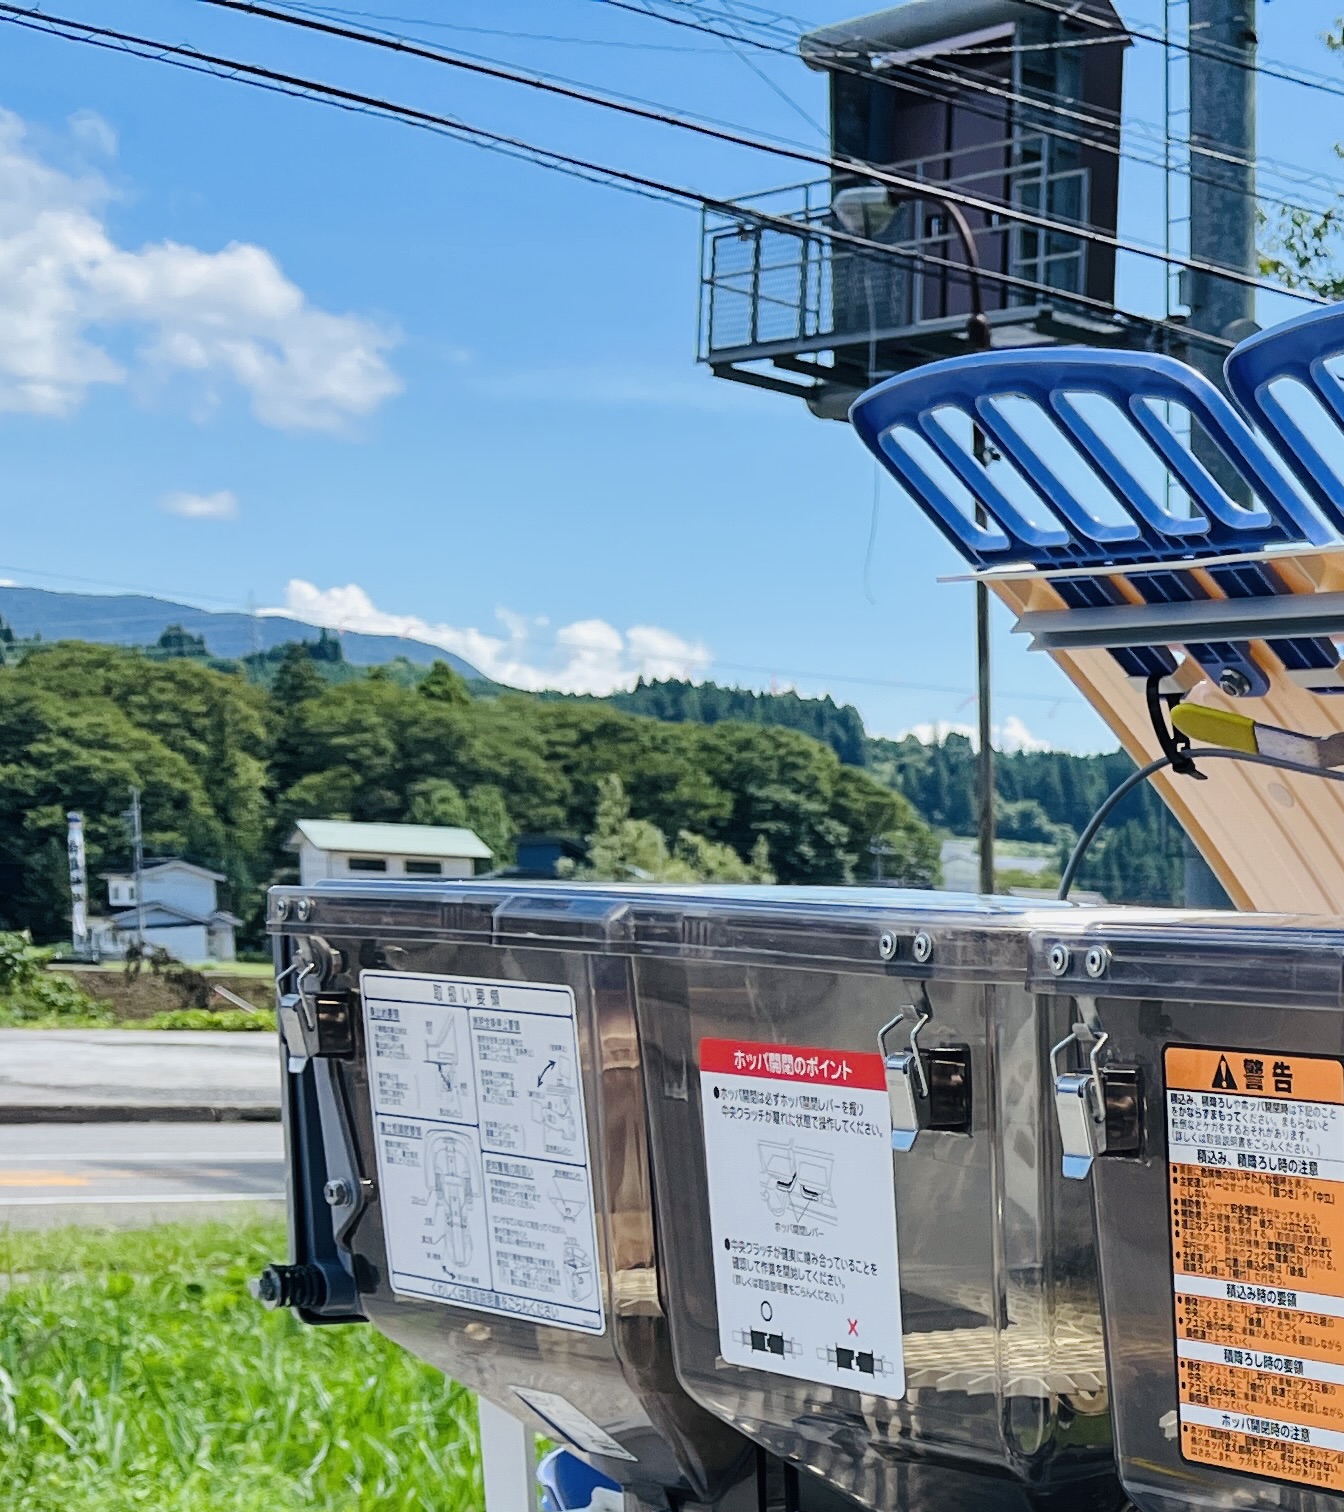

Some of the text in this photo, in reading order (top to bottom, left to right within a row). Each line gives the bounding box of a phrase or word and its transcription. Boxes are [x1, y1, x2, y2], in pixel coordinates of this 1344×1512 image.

[733, 1049, 853, 1081] ホッパ開閉のポイント
[1243, 1058, 1293, 1093] 警告
[1197, 1148, 1318, 1176] 積込み、積降ろし時の注意
[1226, 1282, 1297, 1307] 積込み時の要領
[1224, 1348, 1303, 1376] 積降ろし時の要領
[1221, 1413, 1310, 1443] ホッパ開閉時の注意
